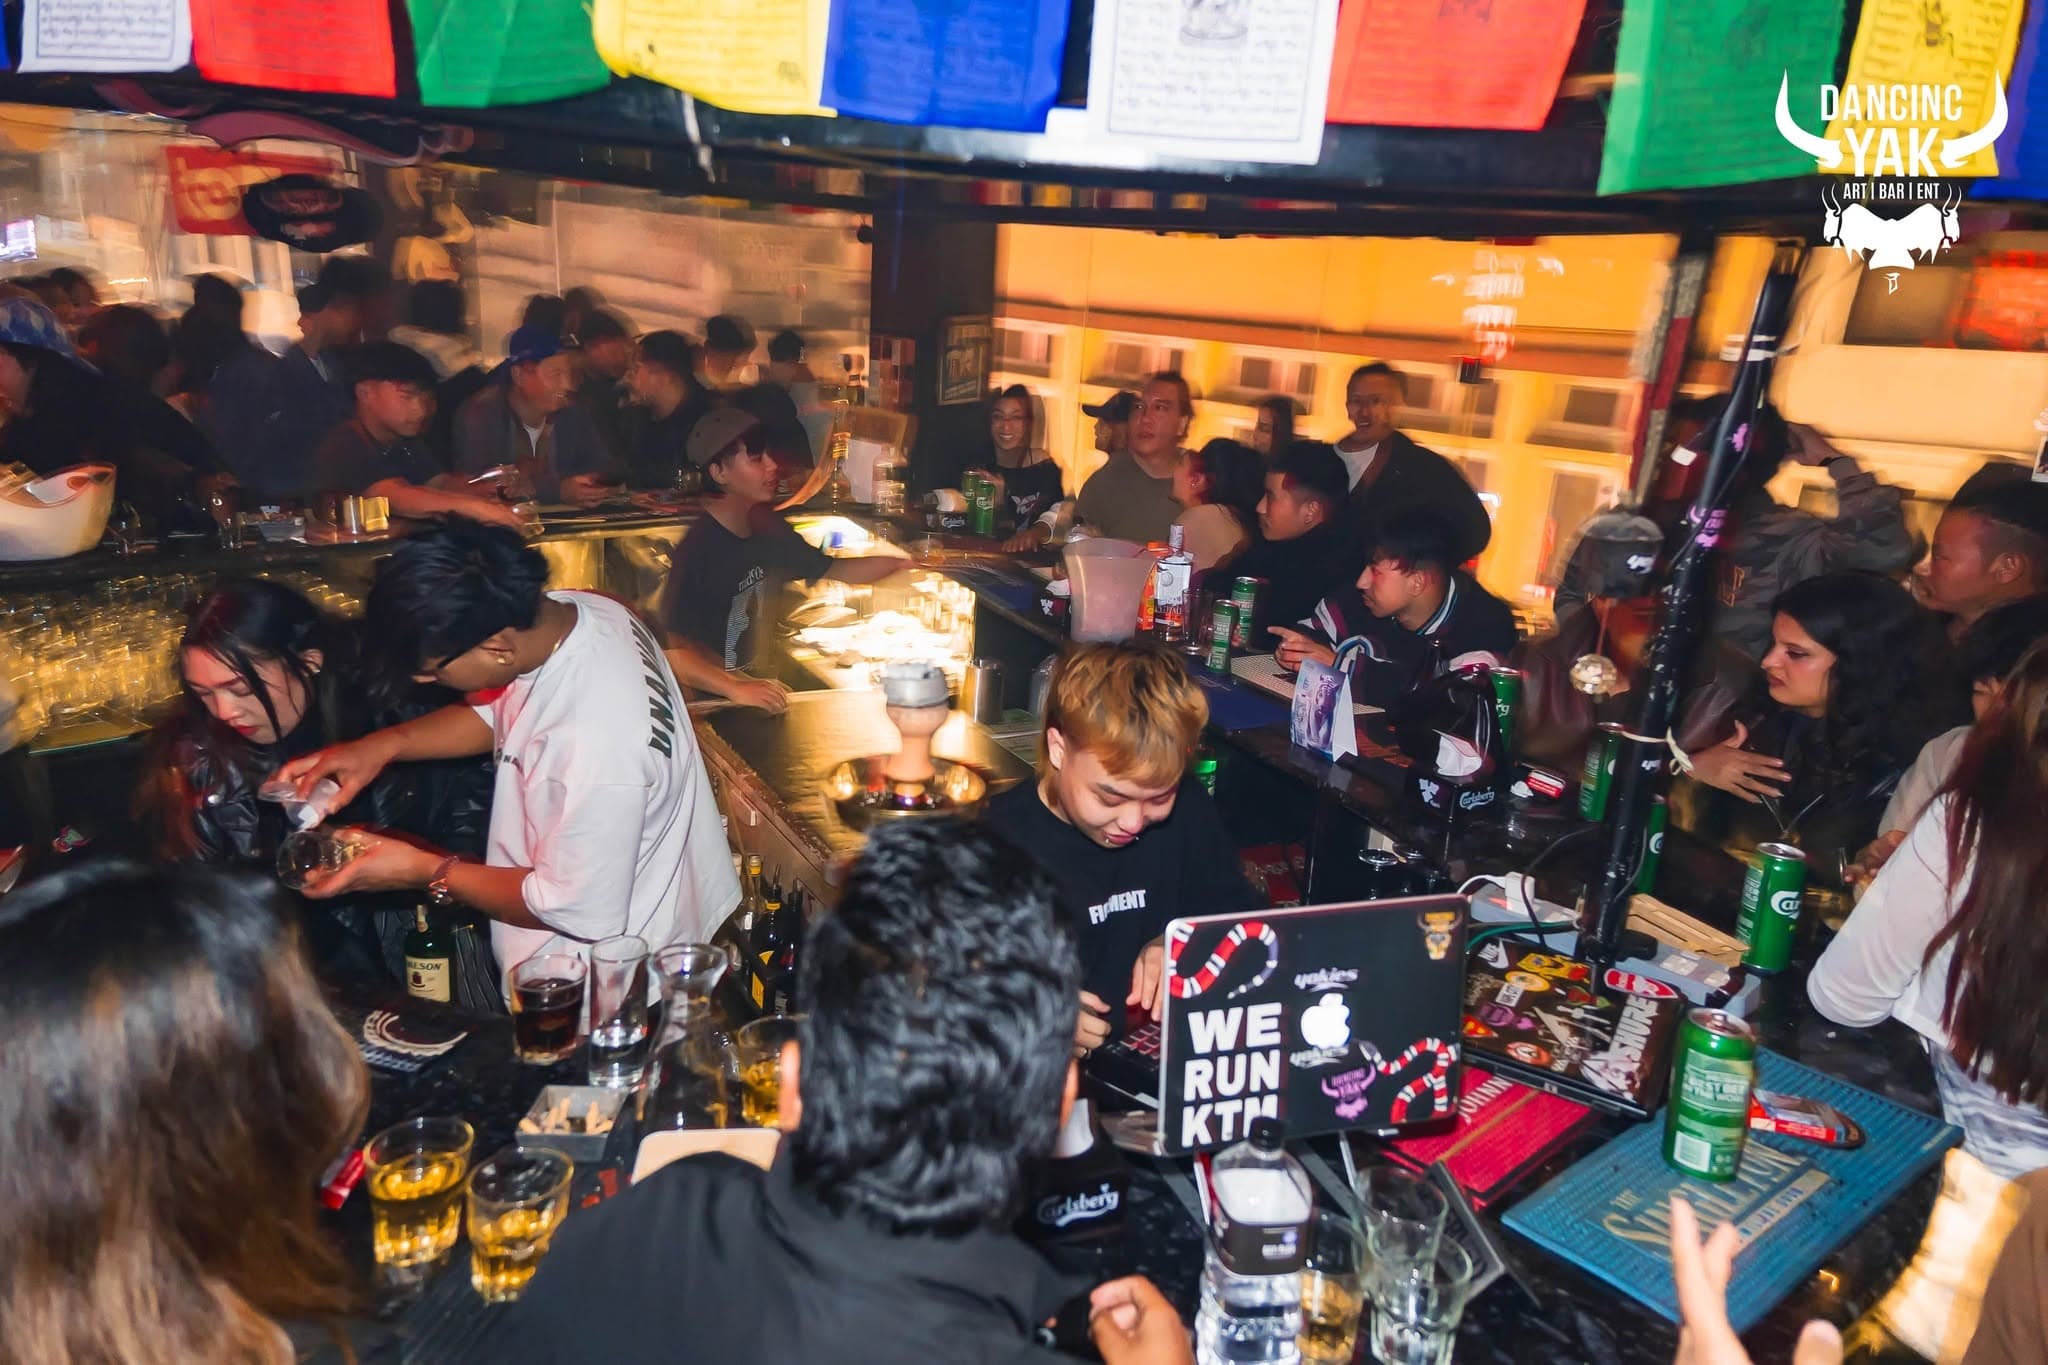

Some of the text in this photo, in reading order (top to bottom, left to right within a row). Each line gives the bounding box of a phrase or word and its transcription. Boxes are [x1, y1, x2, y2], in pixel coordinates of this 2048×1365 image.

[1459, 785, 1495, 810] Carlsberg
[1187, 1002, 1283, 1054] WE
[1609, 993, 1660, 1062] SHURE
[1184, 1049, 1281, 1102] RUN
[1181, 1094, 1279, 1148] KTM
[1036, 1184, 1120, 1227] Carlsberg
